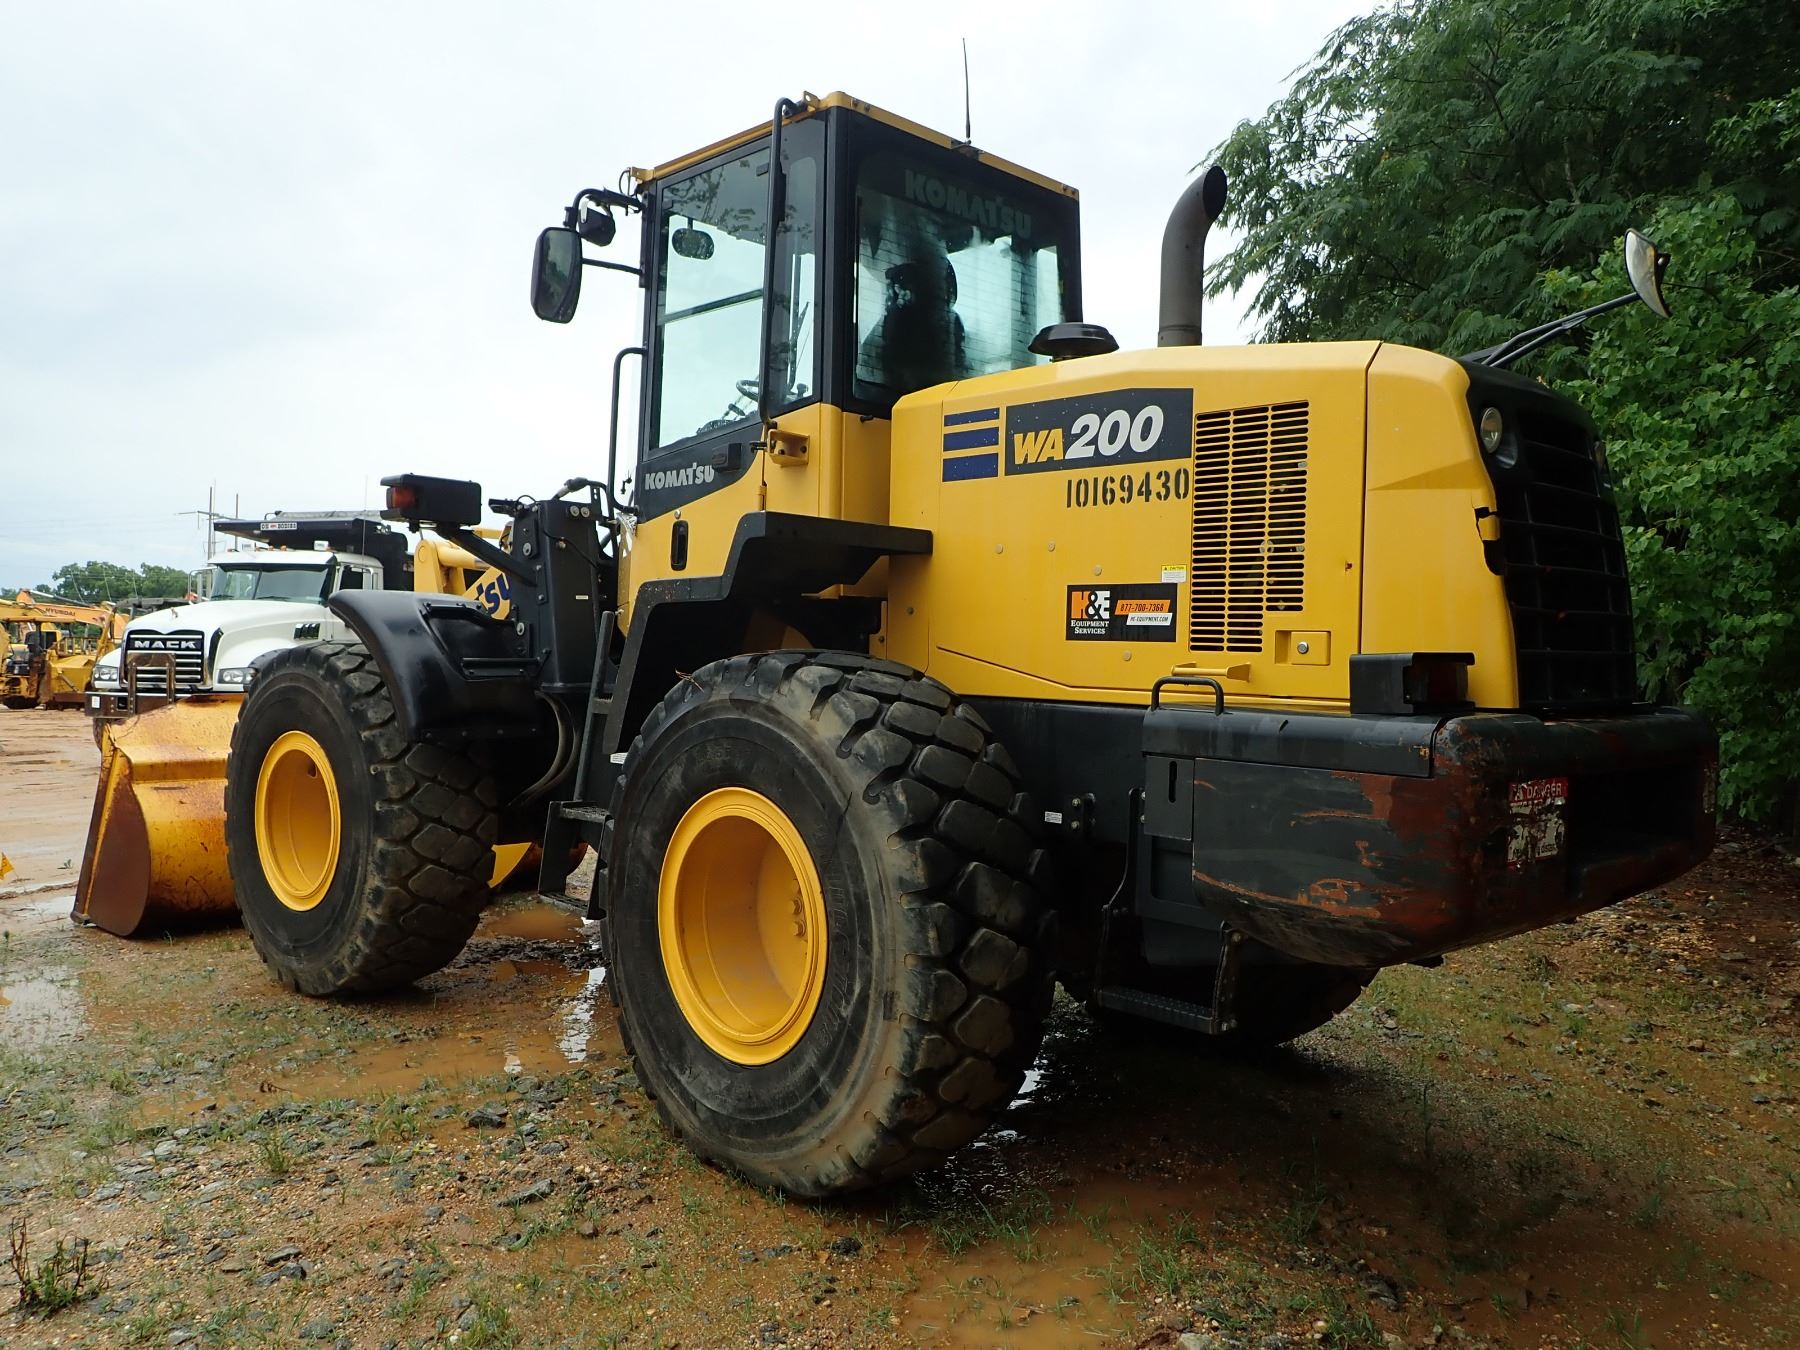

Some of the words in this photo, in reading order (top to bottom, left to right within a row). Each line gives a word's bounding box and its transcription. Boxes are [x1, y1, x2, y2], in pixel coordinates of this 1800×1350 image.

[904, 168, 1032, 240] KOMATSU
[1013, 405, 1164, 465] WA200
[645, 462, 715, 490] KOMATSU
[1066, 467, 1190, 508] 10169430
[1071, 590, 1111, 619] H&E
[134, 640, 196, 649] MACK
